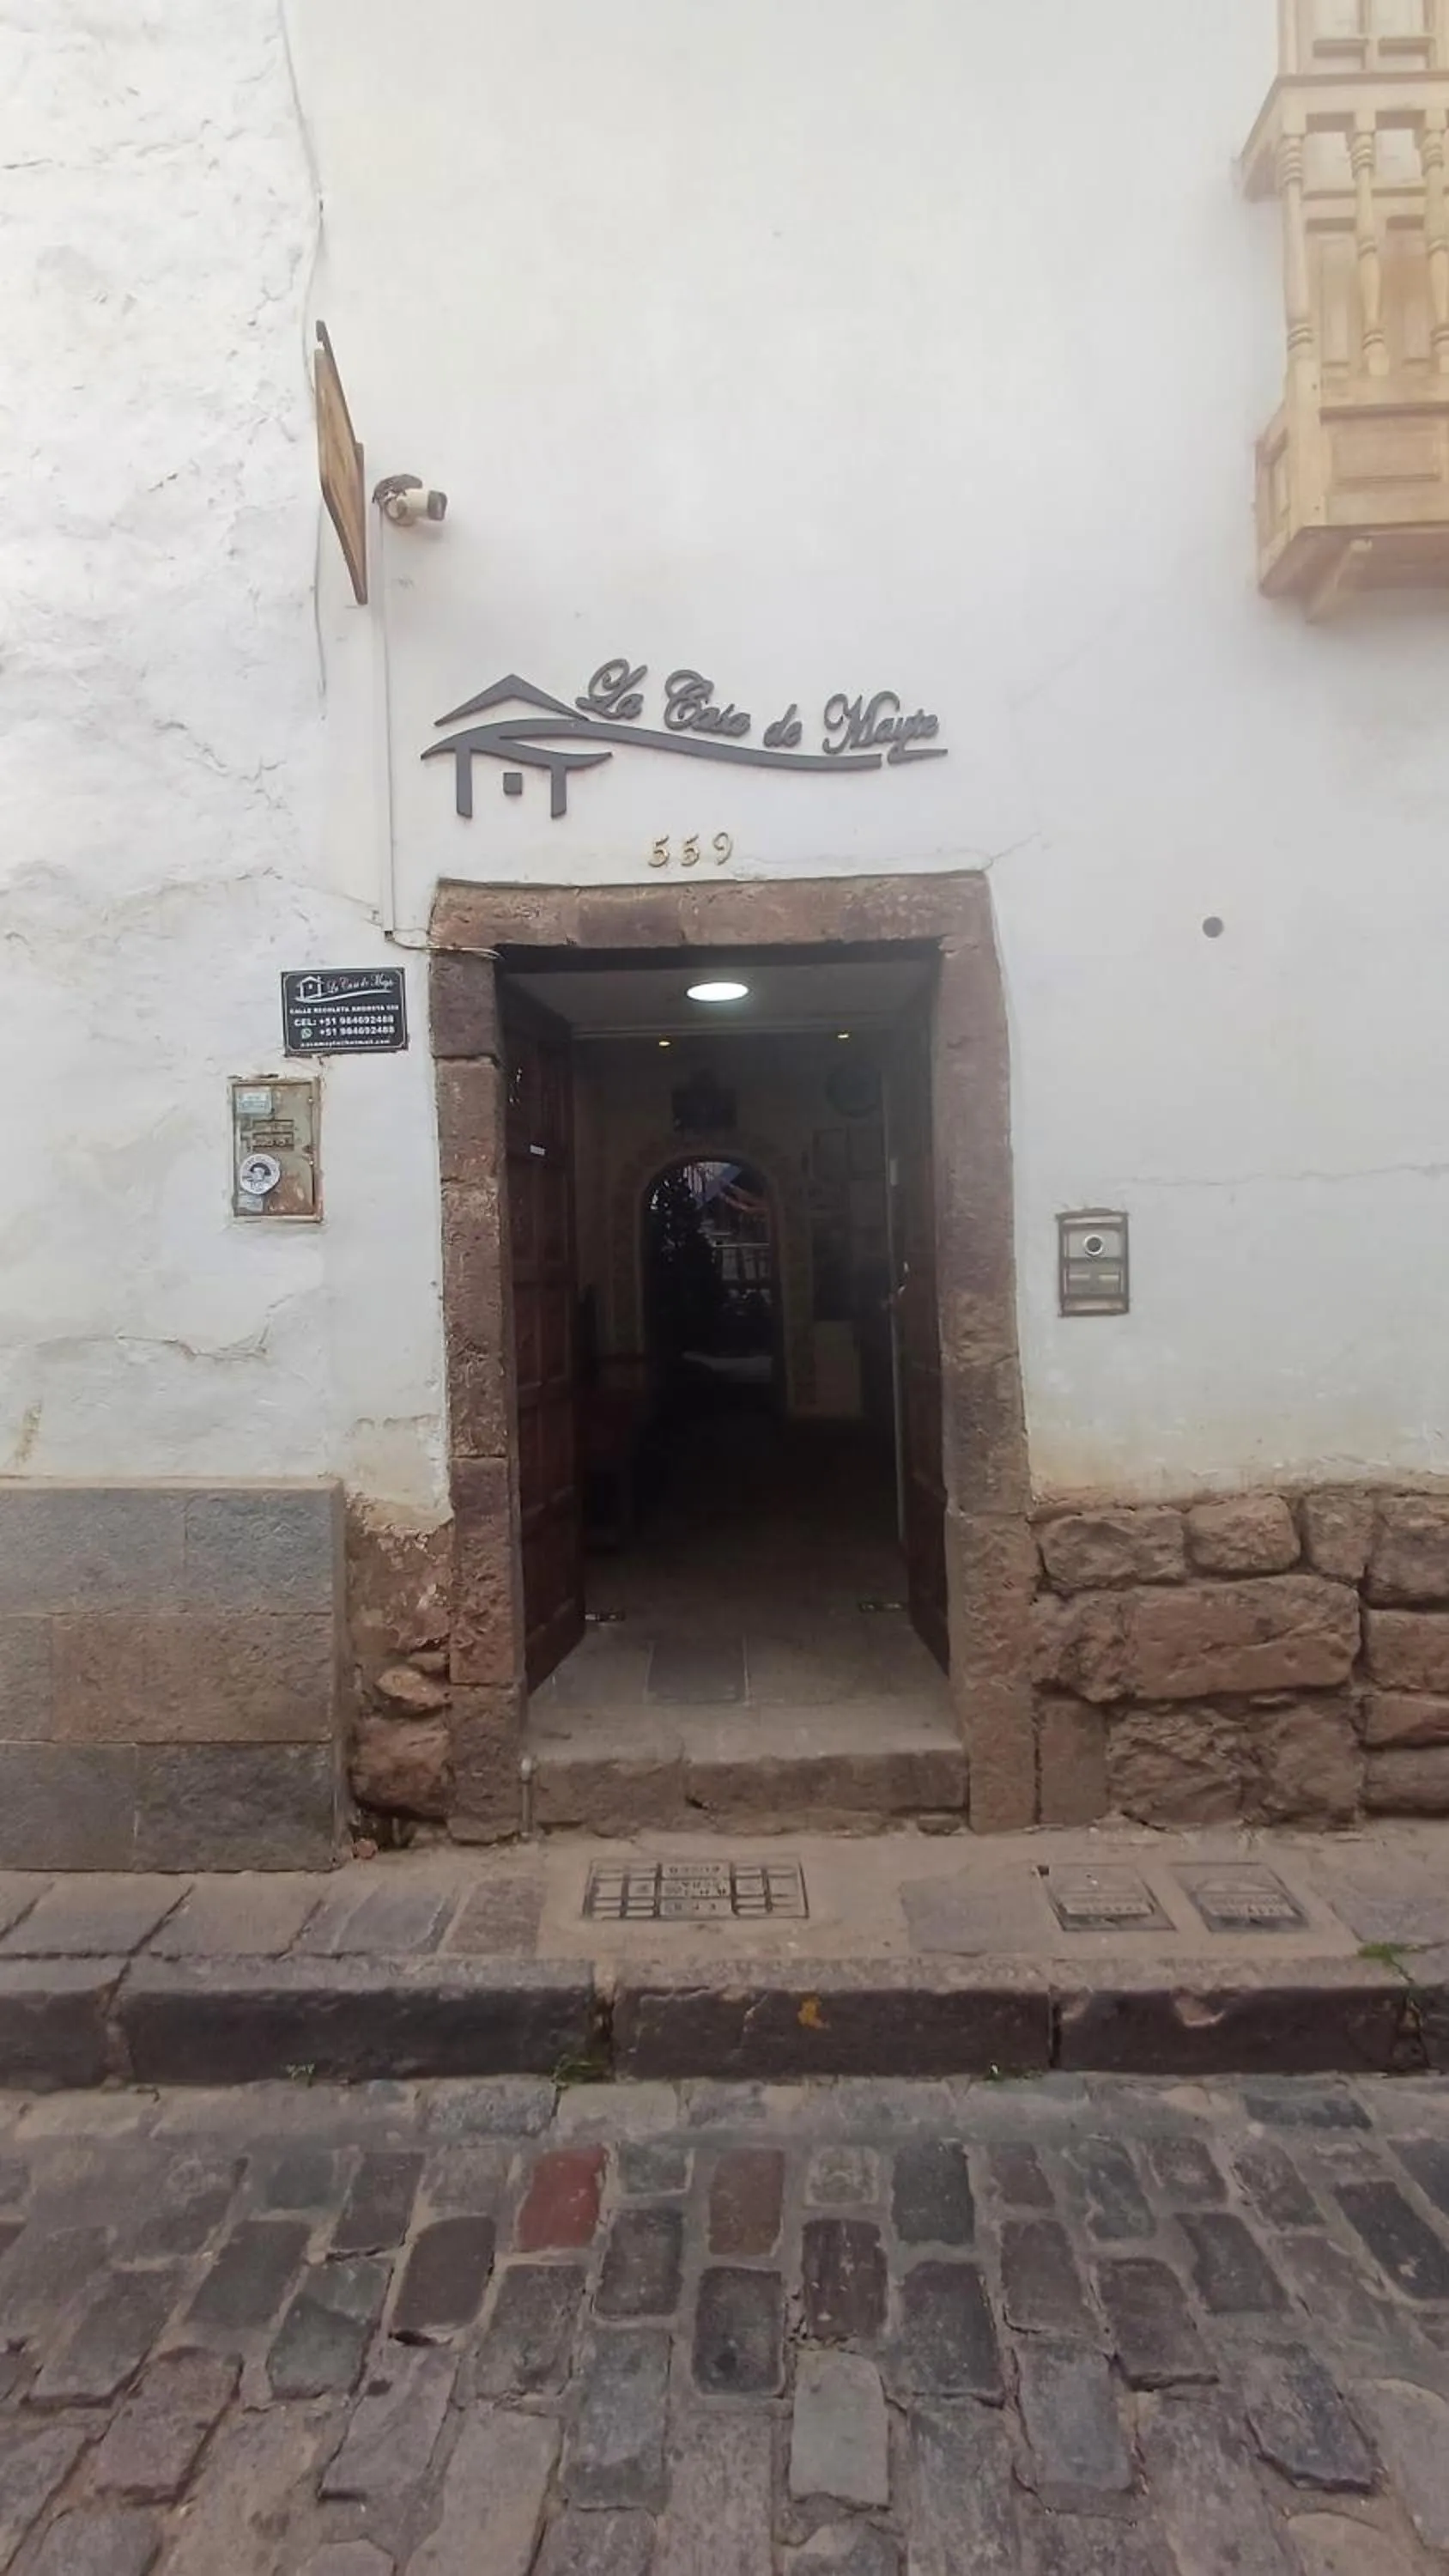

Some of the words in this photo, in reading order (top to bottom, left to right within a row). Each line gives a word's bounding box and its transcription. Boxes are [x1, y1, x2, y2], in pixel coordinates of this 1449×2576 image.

[575, 658, 648, 720] La
[664, 668, 751, 737] Casa
[764, 703, 802, 749] de
[822, 690, 948, 765] Mayte
[648, 832, 733, 868] 559
[294, 1018, 317, 1026] CEL:
[319, 1017, 336, 1025] +51
[319, 1027, 336, 1036] +51
